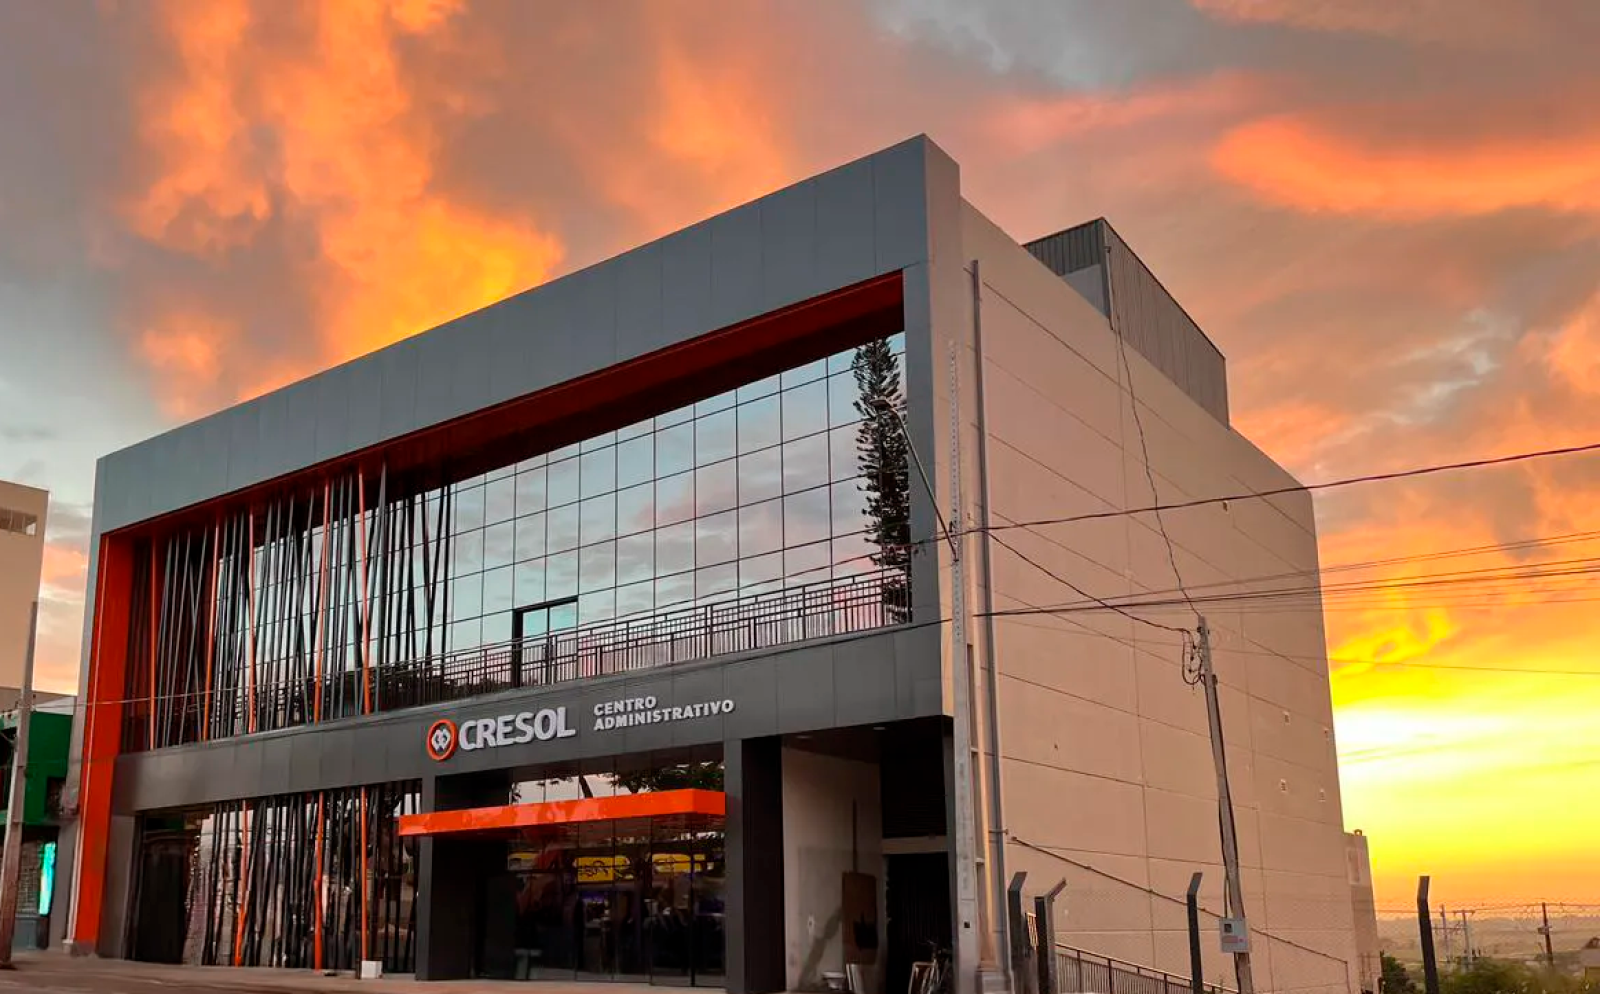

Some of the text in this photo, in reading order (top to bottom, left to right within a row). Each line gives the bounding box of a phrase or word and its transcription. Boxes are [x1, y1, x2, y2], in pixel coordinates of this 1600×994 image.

[594, 696, 657, 716] CENTRO
[594, 700, 735, 731] ADMINISTRATIVO
[458, 707, 576, 750] CRESOL
